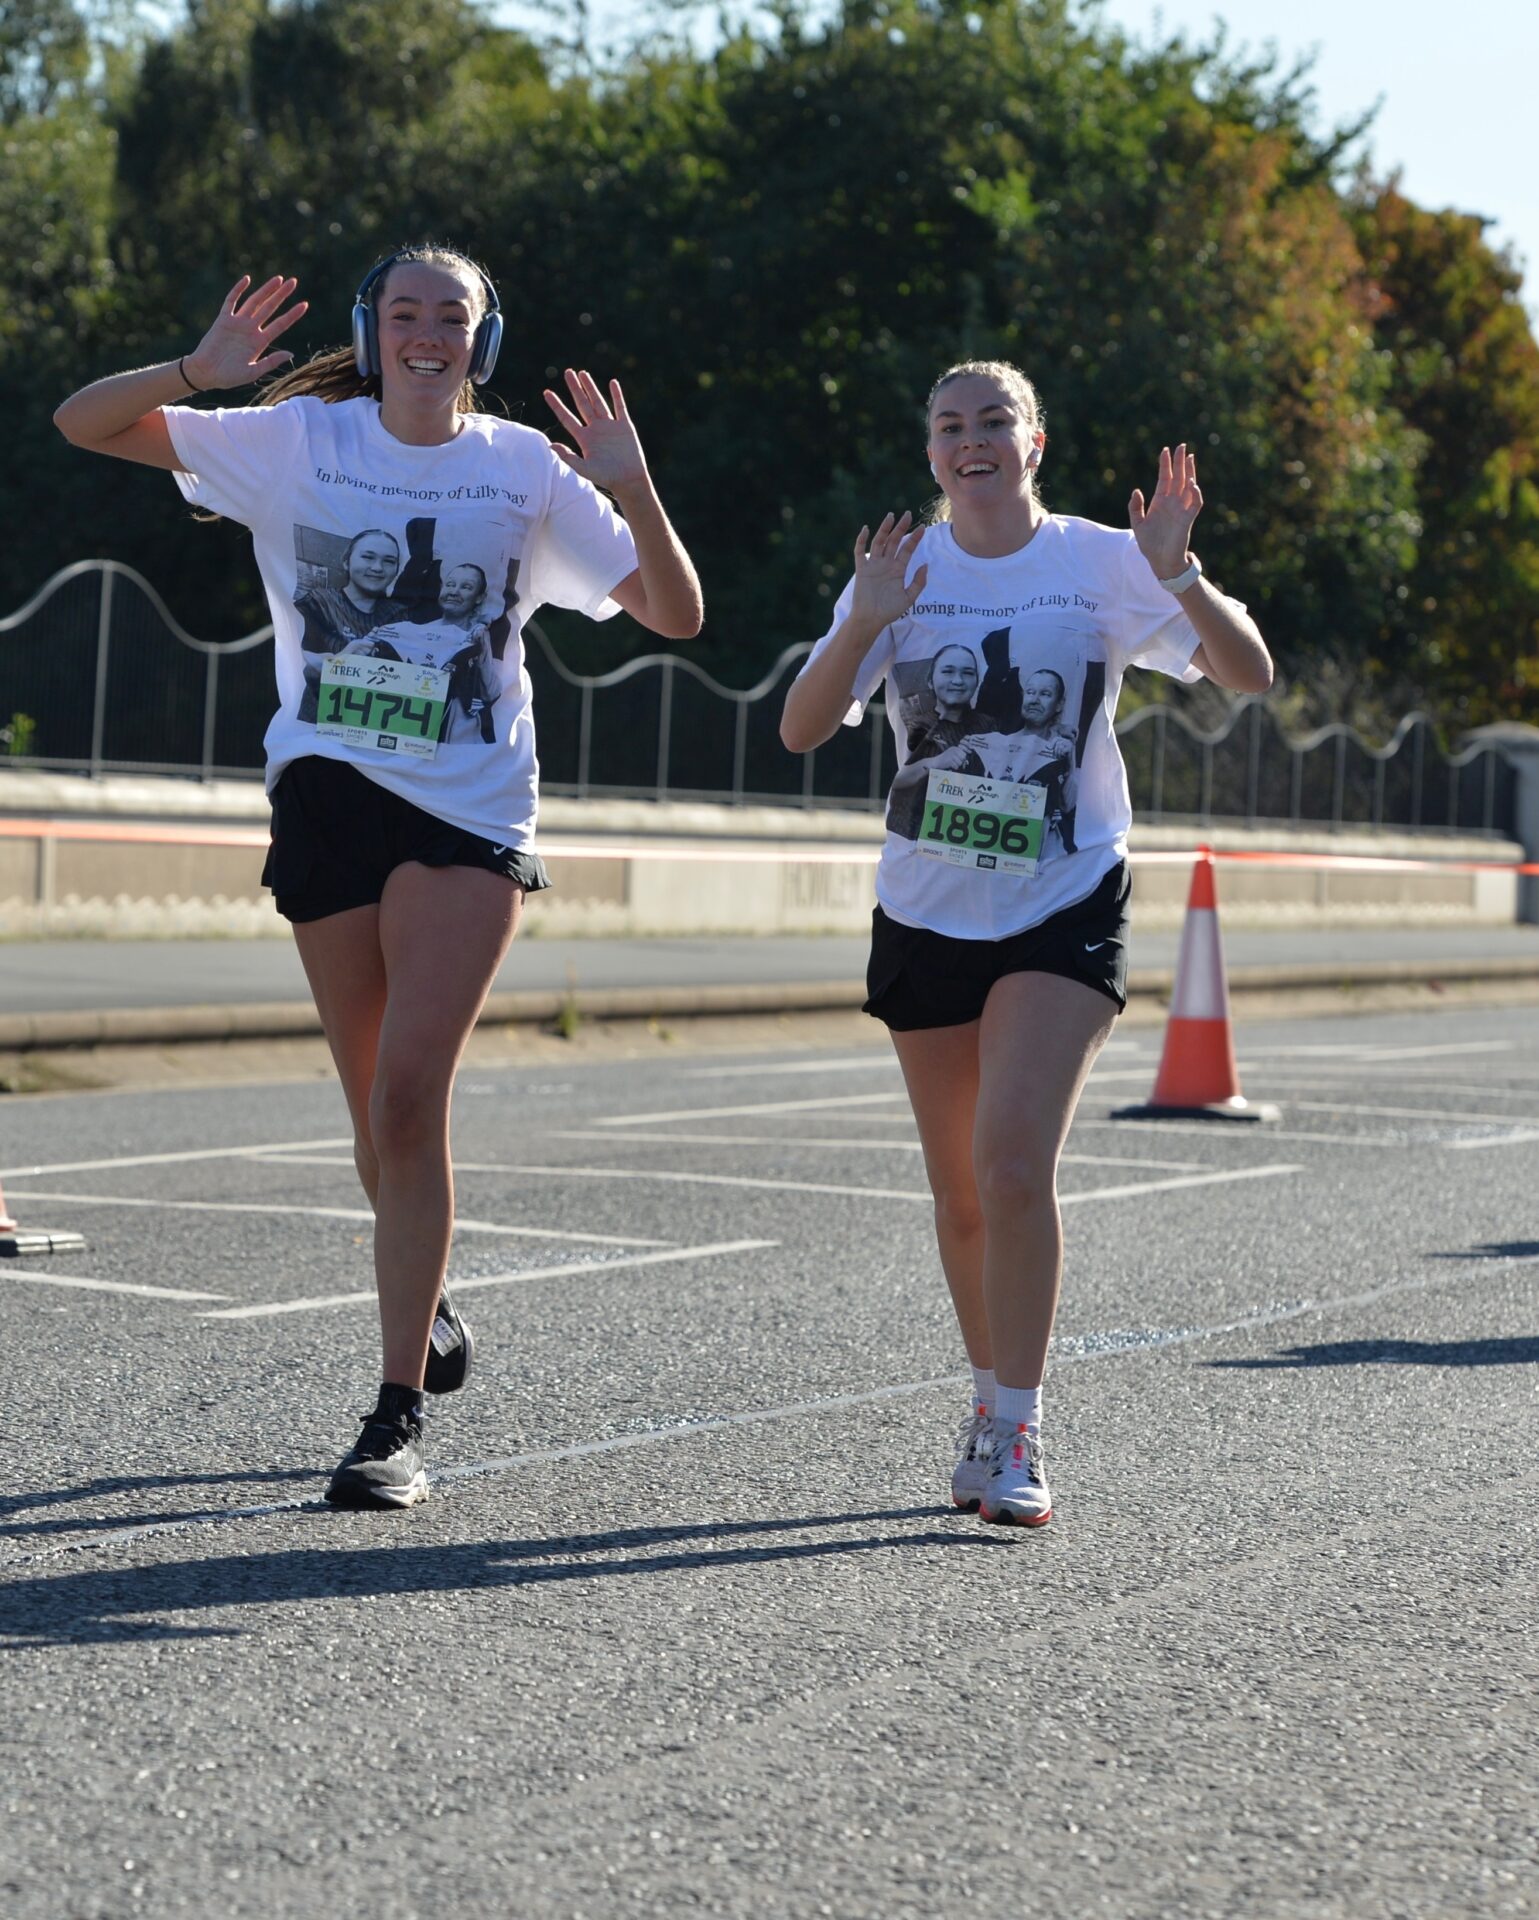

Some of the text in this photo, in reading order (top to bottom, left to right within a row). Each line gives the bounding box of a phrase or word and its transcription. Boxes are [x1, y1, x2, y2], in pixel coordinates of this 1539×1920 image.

[316, 467, 331, 483] In
[334, 470, 376, 494] loving
[381, 486, 443, 502] memory
[448, 486, 462, 499] of
[466, 486, 499, 500] Lilly
[912, 601, 955, 616] loving
[959, 605, 1018, 618] memory
[1022, 598, 1037, 612] of
[1039, 594, 1069, 607] Lilly
[1074, 594, 1098, 613] Day
[334, 665, 361, 678] TREK
[326, 687, 433, 736] 1474
[940, 783, 963, 797] TREK
[927, 805, 1029, 854] 1896
